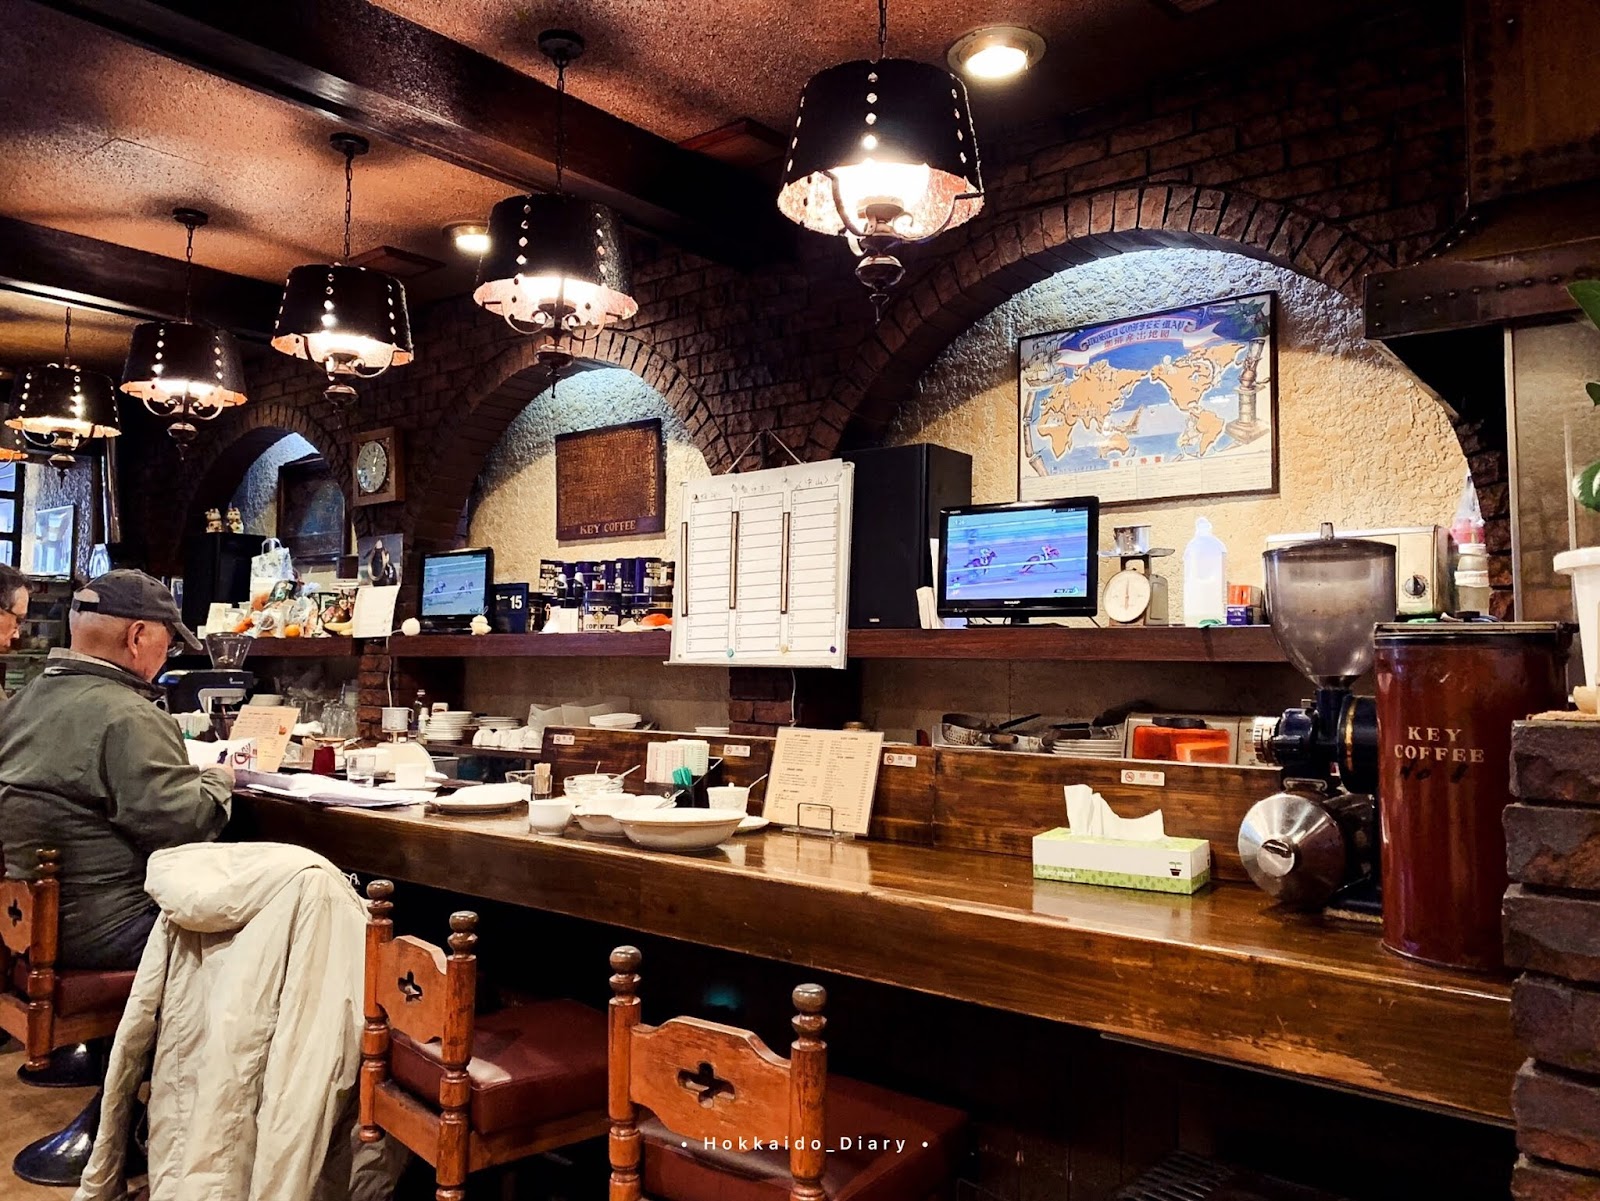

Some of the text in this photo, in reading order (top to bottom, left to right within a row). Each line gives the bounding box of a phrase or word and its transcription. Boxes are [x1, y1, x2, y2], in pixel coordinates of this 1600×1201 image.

[1119, 320, 1161, 335] COFFEE
[580, 520, 636, 535] KEY COFFEE
[510, 595, 523, 609] 15
[1408, 726, 1462, 742] KEY
[1394, 744, 1485, 763] COFFEE
